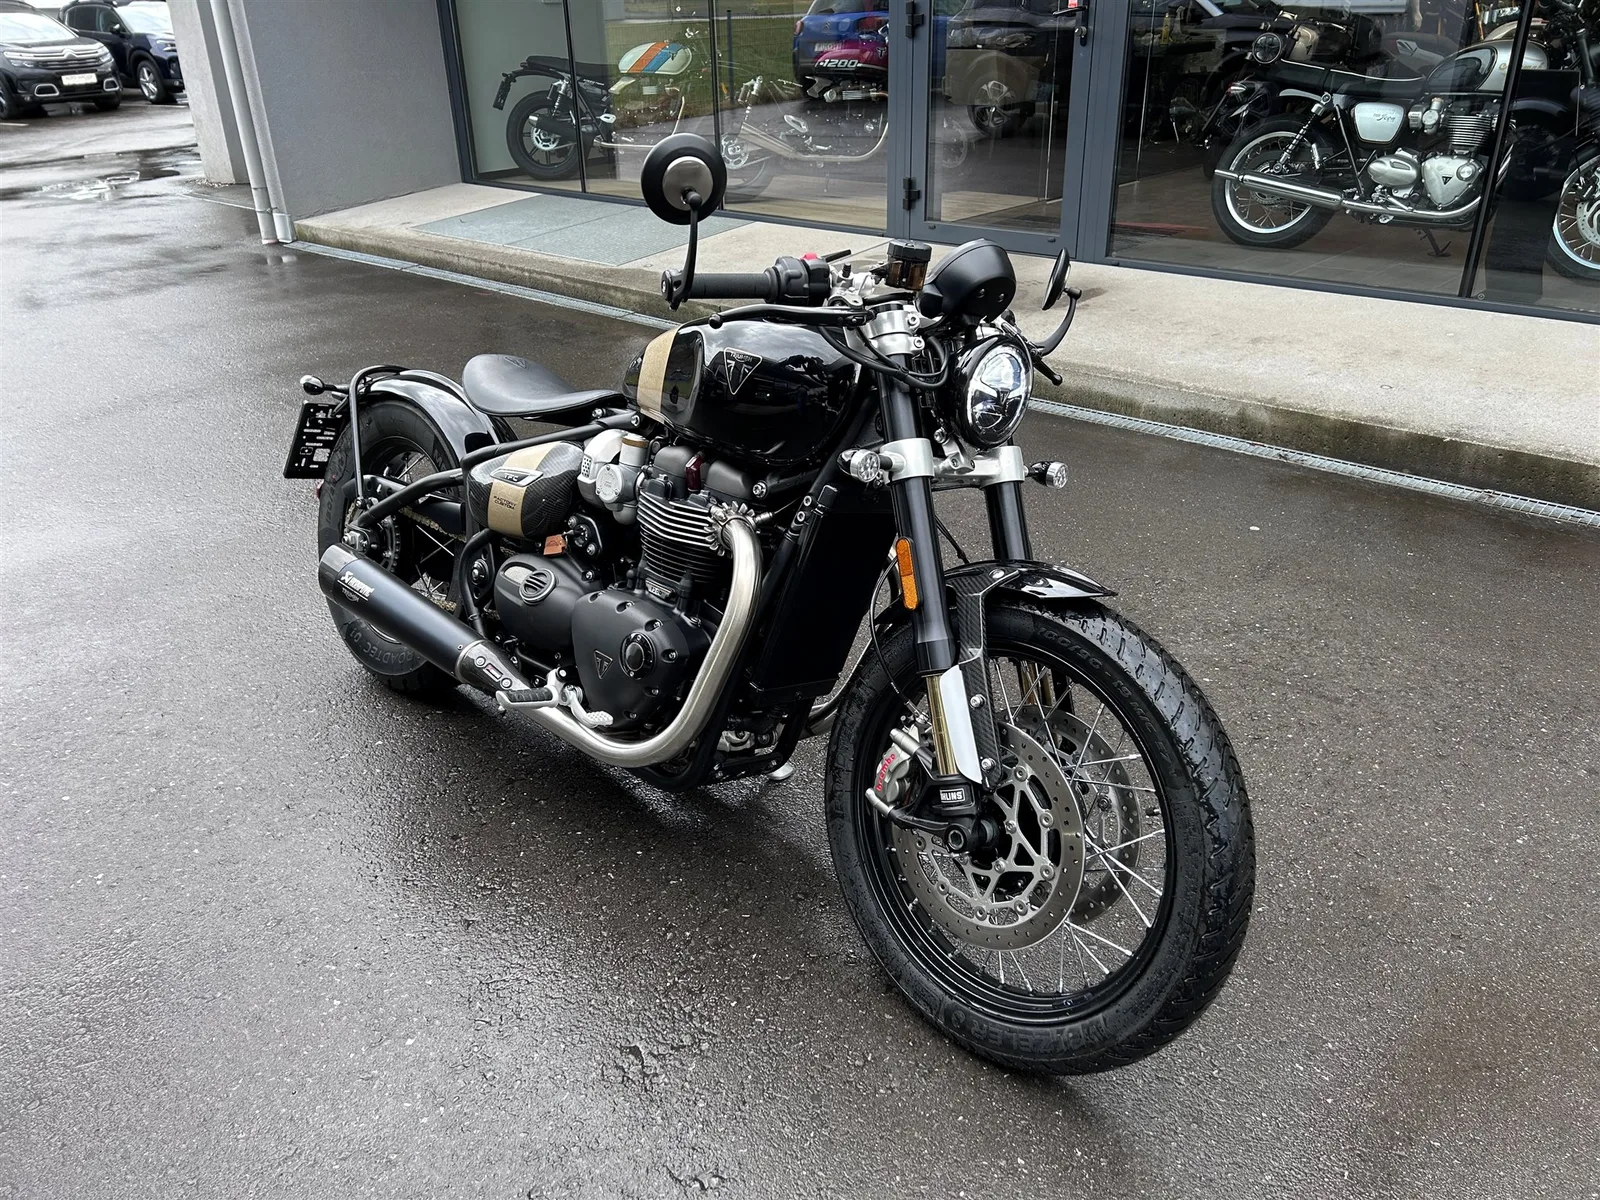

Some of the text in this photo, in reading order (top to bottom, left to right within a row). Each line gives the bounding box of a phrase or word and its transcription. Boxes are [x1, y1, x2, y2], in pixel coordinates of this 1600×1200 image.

[823, 59, 858, 68] 1200
[504, 473, 519, 482] TFC
[349, 627, 413, 664] ROADTEC 01
[876, 753, 896, 792] brembo
